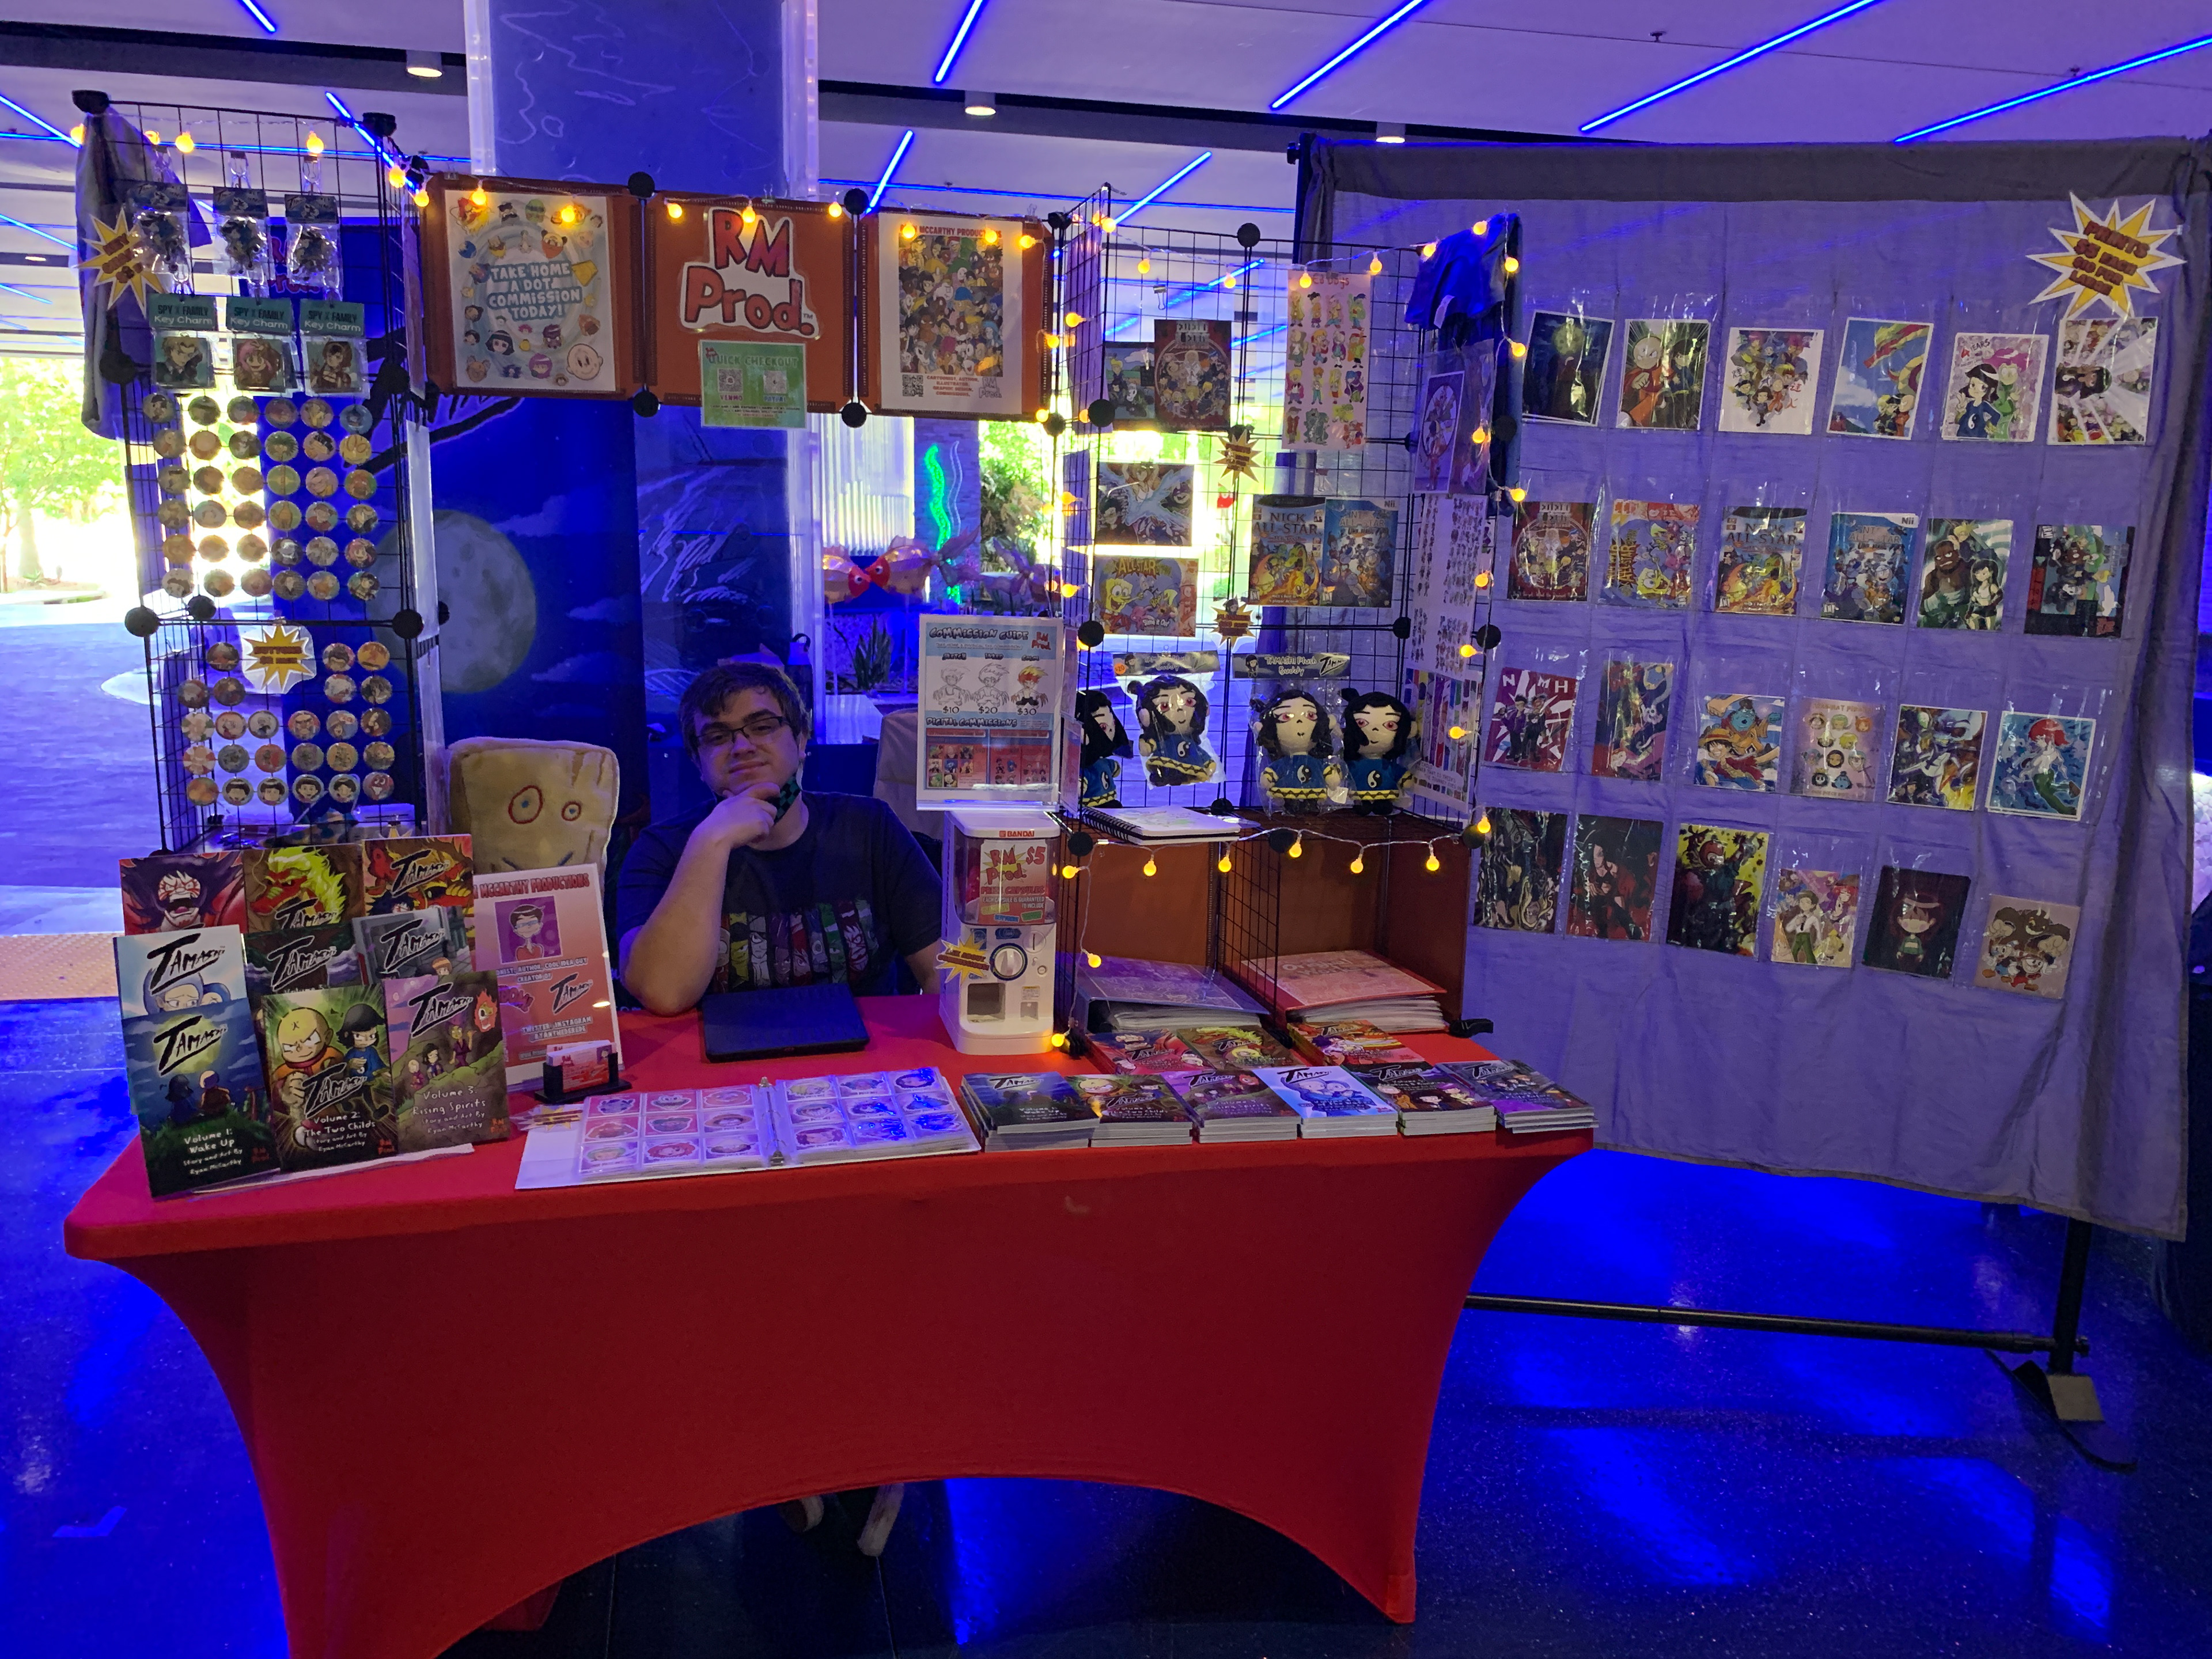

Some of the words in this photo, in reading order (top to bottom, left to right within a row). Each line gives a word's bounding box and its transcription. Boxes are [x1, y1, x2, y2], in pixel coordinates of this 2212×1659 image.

[919, 226, 955, 234] MCCARTHY
[713, 209, 790, 278] RM
[491, 266, 526, 280] TAKE
[530, 263, 570, 277] HOME
[511, 280, 518, 292] A
[523, 278, 551, 291] DOT
[490, 289, 580, 307] COMMISSION
[684, 265, 815, 336] Prod.
[158, 305, 172, 314] SPY
[183, 306, 209, 316] FAMILY
[234, 307, 249, 316] SPY
[259, 308, 284, 320] FAMILY
[309, 310, 322, 320] SPY
[332, 312, 357, 323] FAMILY
[511, 304, 563, 319] TODAY!
[155, 316, 175, 325] Key
[177, 317, 212, 325] Charm
[232, 317, 249, 327] Key
[253, 319, 287, 329] Charm
[304, 321, 325, 330] Key
[328, 323, 360, 332] Charm
[745, 355, 799, 368] CHECKOUT
[1270, 513, 1306, 522] NICK
[929, 627, 998, 640] COMMISSION
[999, 631, 1029, 640] GUIDE
[1297, 656, 1317, 665] Plush
[1278, 666, 1305, 676] Buddy
[926, 717, 958, 726] DIGITAL
[959, 718, 1017, 728] COMMISSIONS
[990, 847, 1016, 867] RM
[1026, 846, 1046, 865] $5
[986, 863, 1027, 885] Prod.
[480, 879, 529, 898] MCCARTHY
[531, 873, 590, 893] PRODUCTIONS
[1005, 886, 1045, 895] CAPSULES
[517, 975, 543, 983] CREATOR
[423, 1089, 462, 1100] Volume
[412, 1106, 445, 1115] Rising
[449, 1100, 486, 1112] Spirits
[314, 1114, 347, 1123] Volume
[348, 1121, 375, 1130] Childs
[427, 1126, 446, 1134] Ryan
[448, 1122, 483, 1131] McCarthy
[184, 1132, 221, 1144] Volume
[190, 1143, 217, 1153] Wake
[210, 1160, 241, 1169] McCarthy
